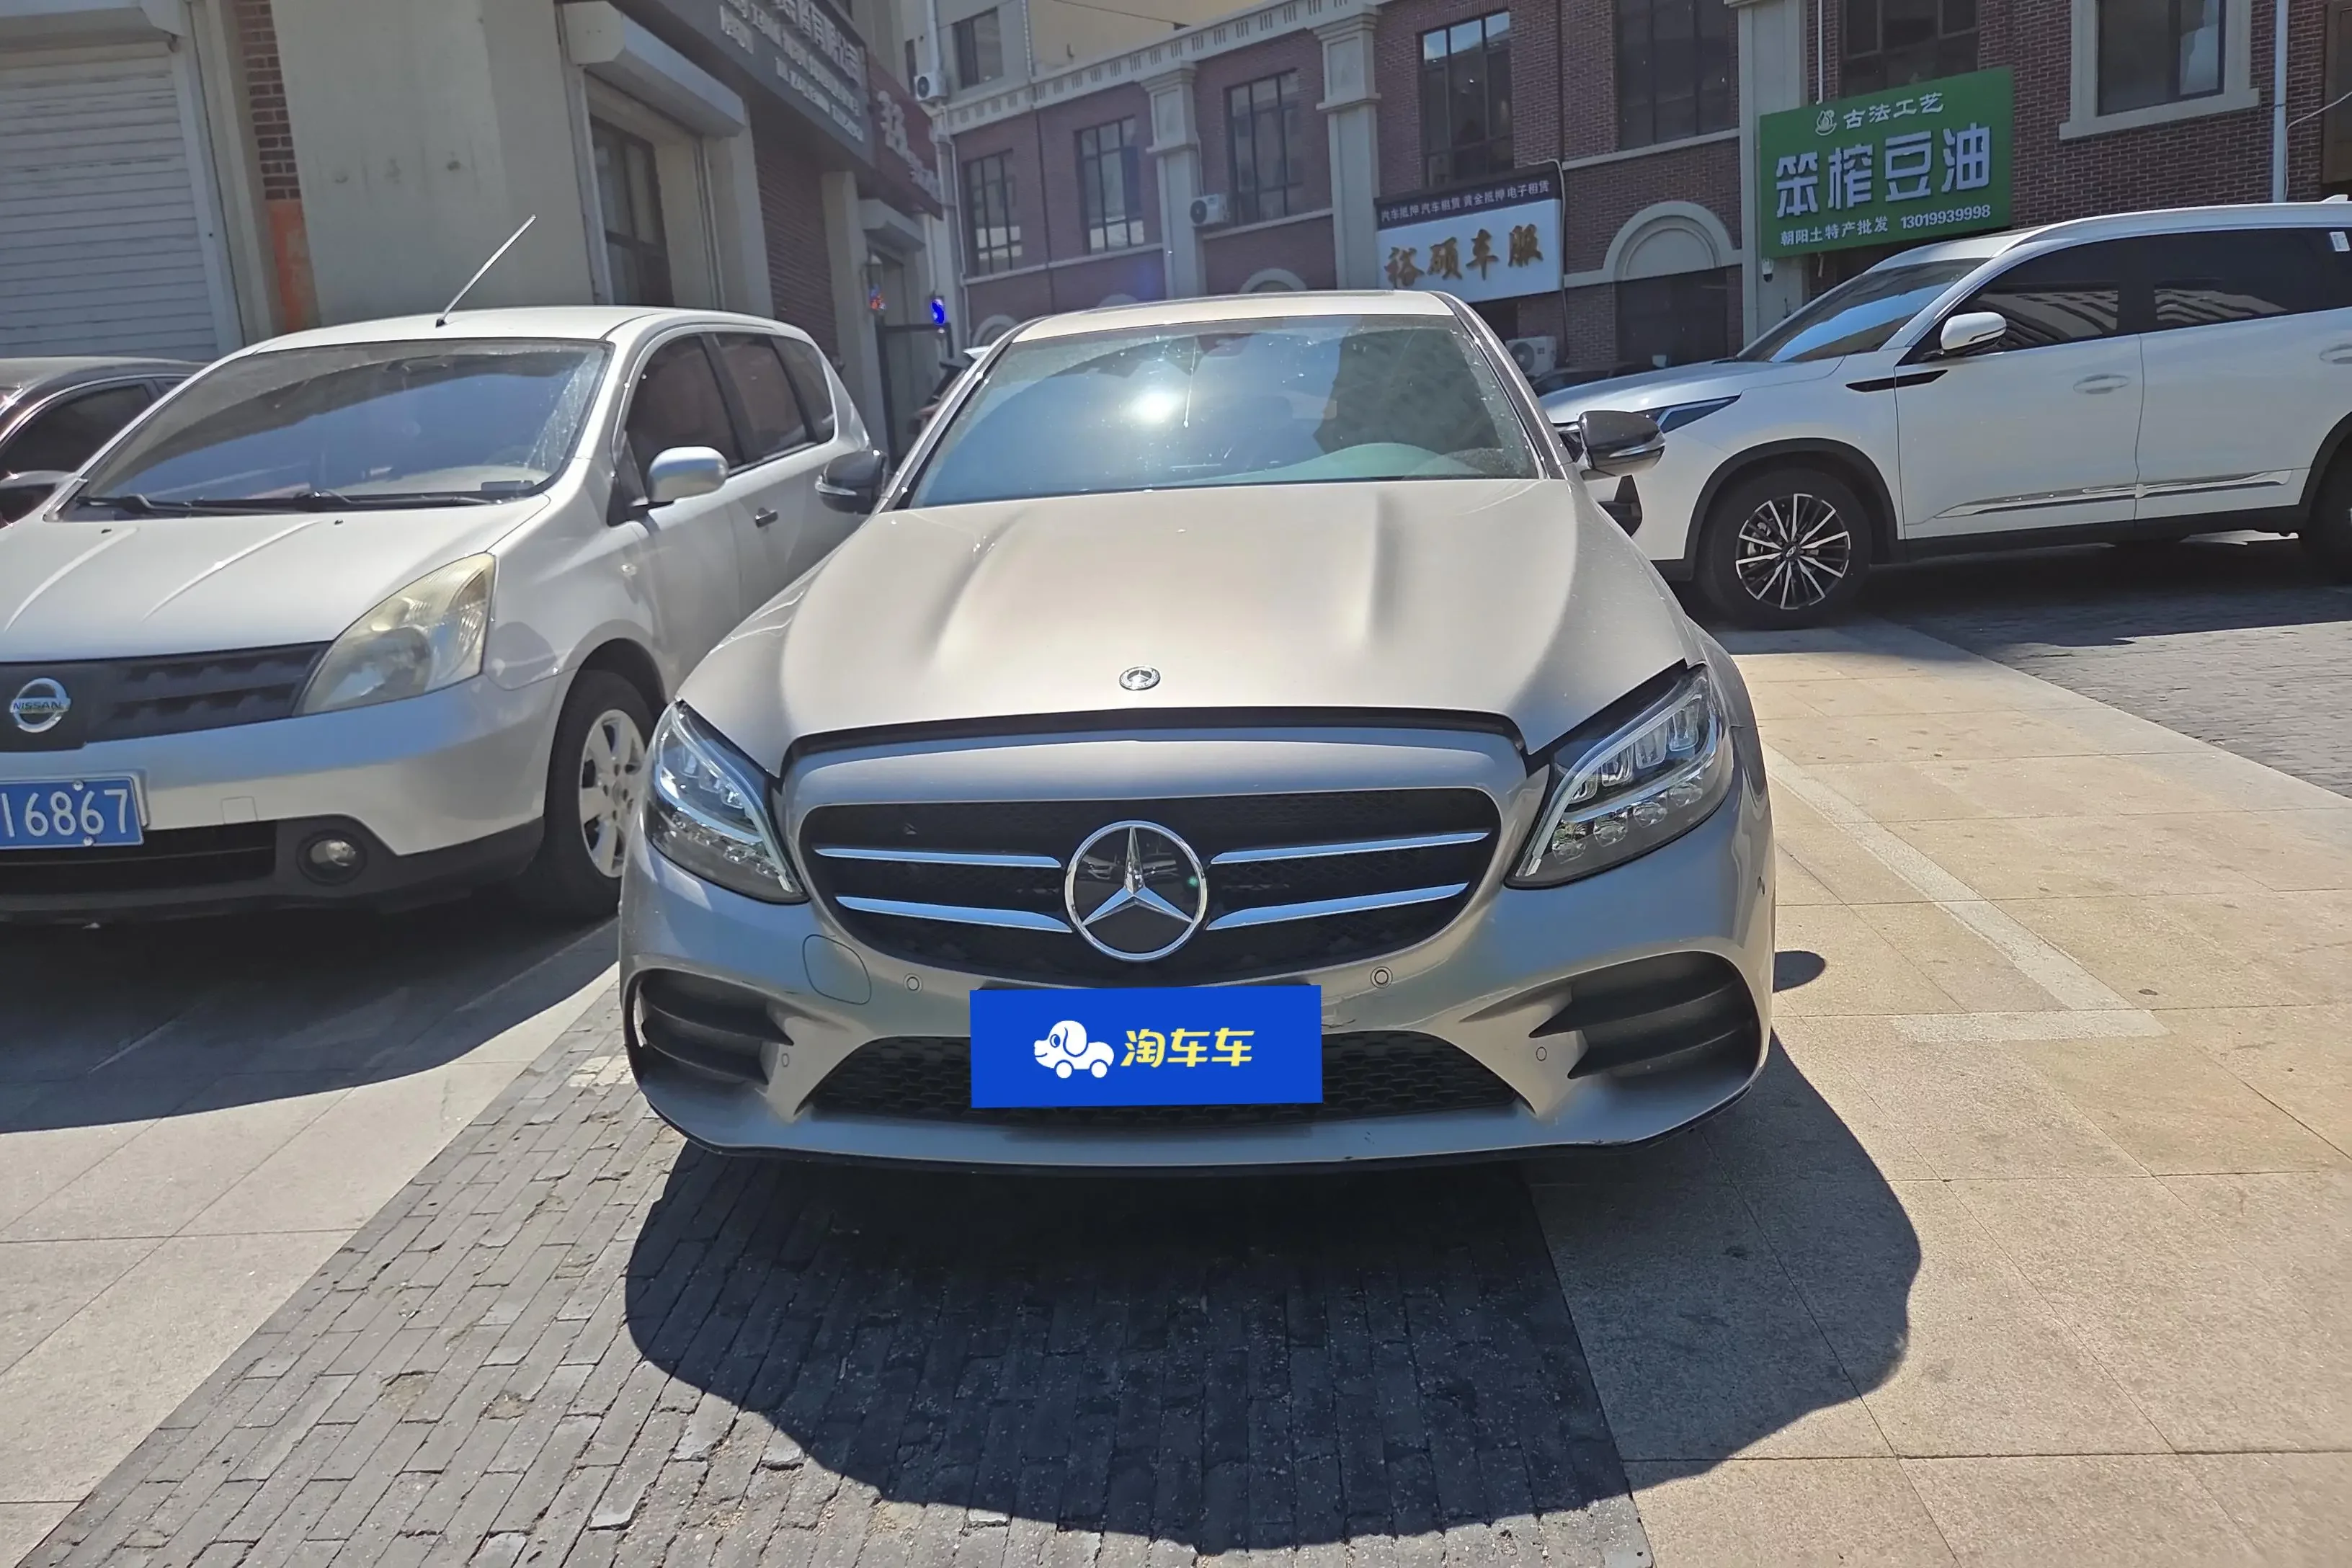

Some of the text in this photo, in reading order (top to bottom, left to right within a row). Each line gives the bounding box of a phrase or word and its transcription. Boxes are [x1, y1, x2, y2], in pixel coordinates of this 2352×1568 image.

[1843, 92, 1945, 130] 古法工艺
[1776, 122, 1992, 218] 笨榨豆油
[1781, 204, 1991, 246] 朝阳土特产批发 13019939998
[13, 700, 62, 710] NISSAN
